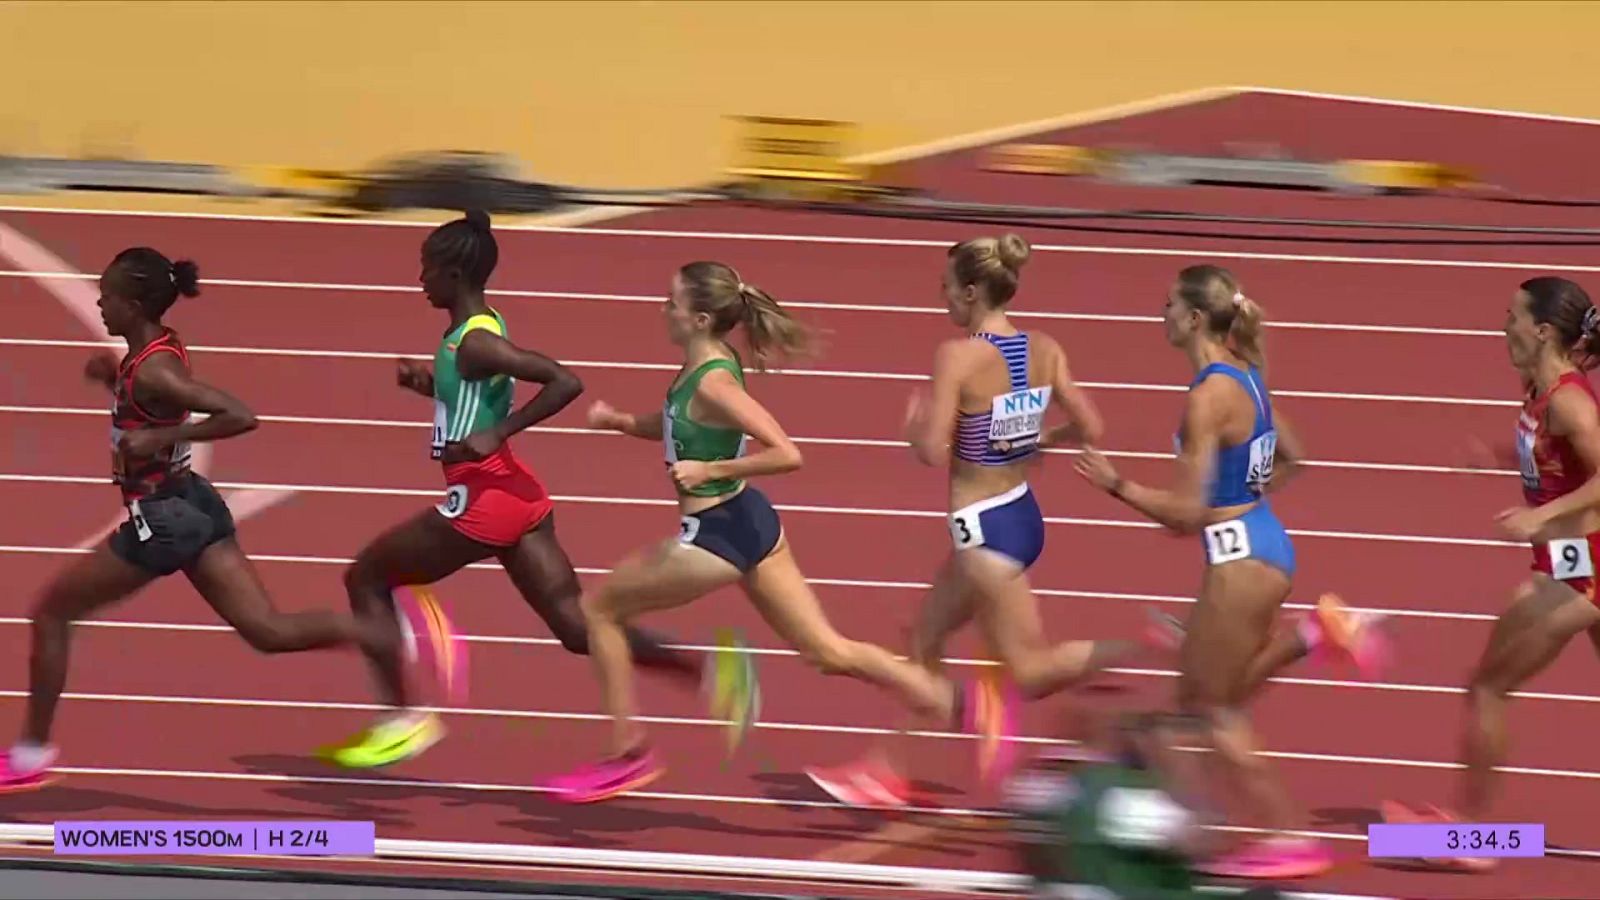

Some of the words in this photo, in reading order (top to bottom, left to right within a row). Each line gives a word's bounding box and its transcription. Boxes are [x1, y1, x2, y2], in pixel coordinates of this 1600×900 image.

[1004, 390, 1043, 414] NTN
[954, 517, 971, 544] 3
[1213, 527, 1242, 555] 12
[1562, 544, 1579, 572] 9
